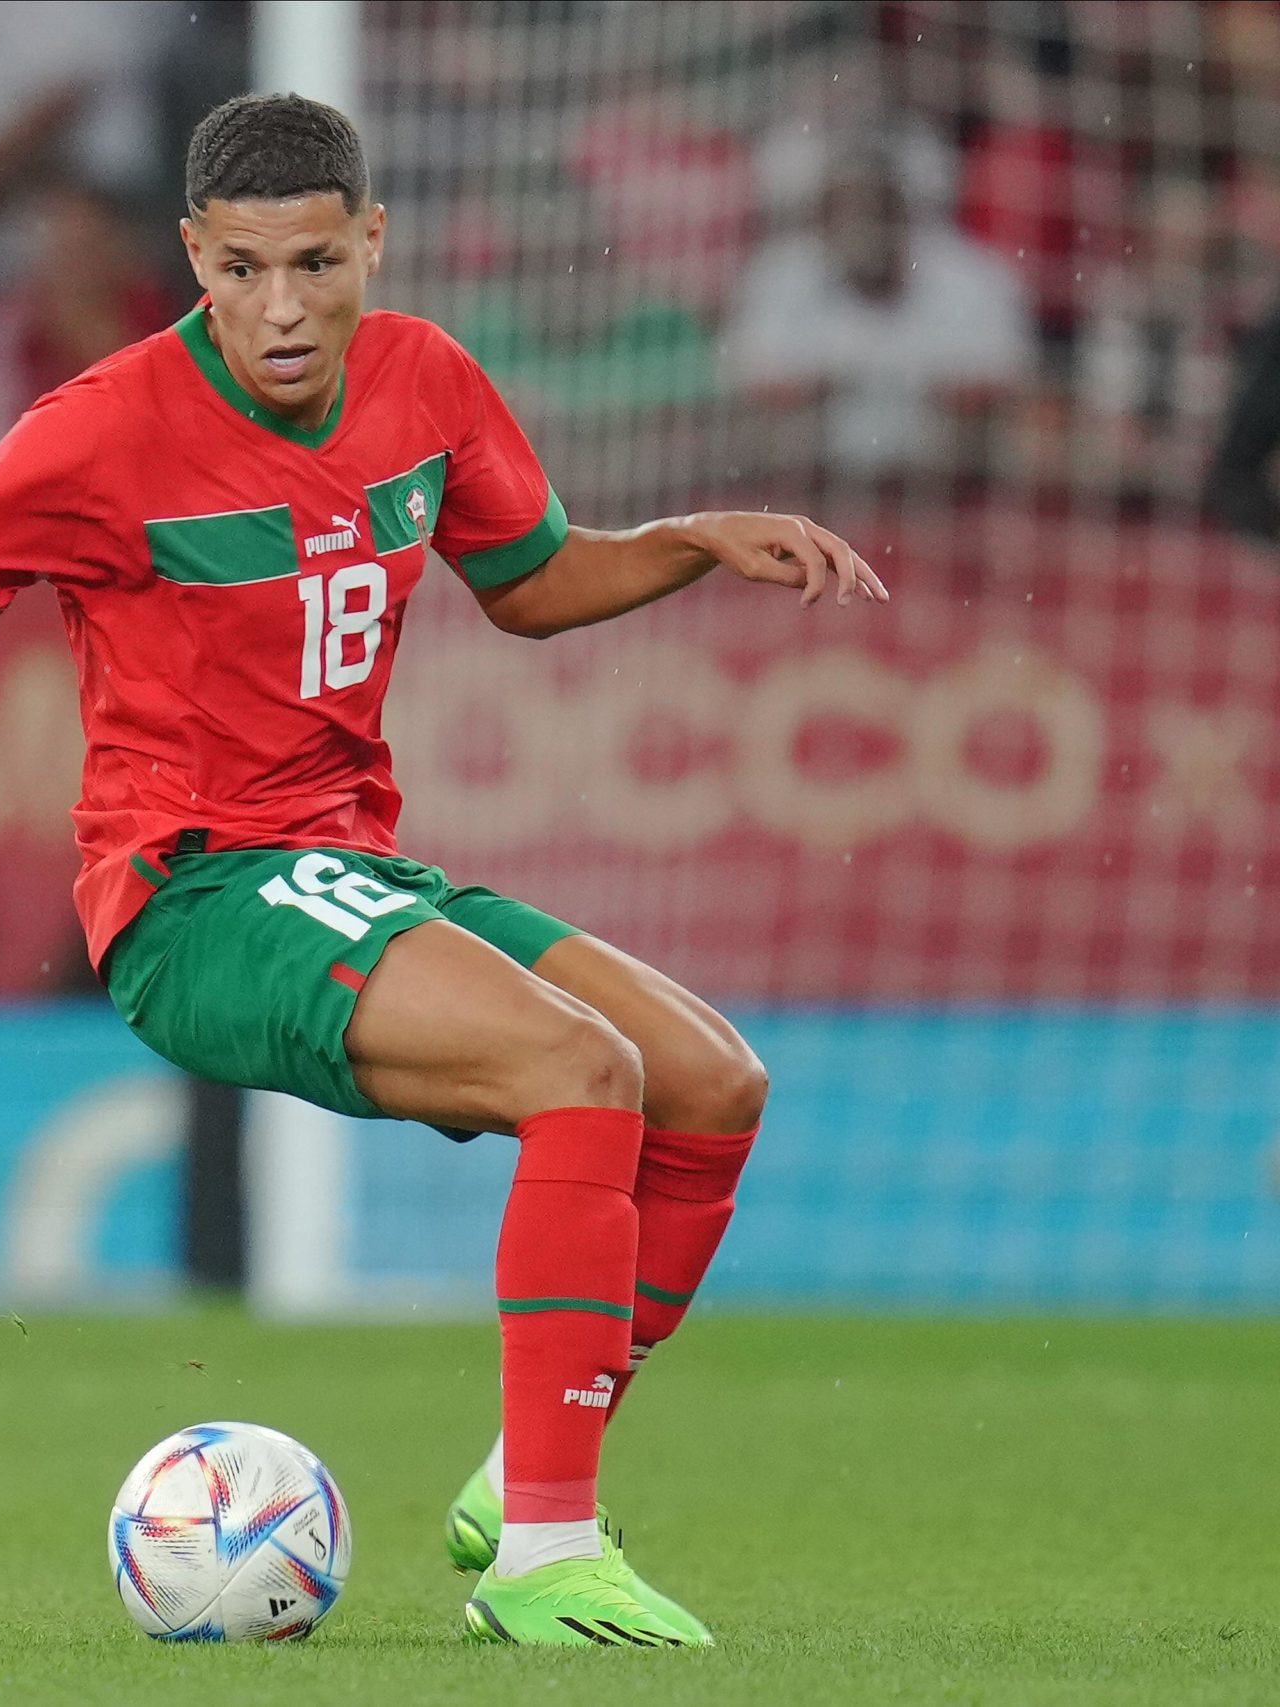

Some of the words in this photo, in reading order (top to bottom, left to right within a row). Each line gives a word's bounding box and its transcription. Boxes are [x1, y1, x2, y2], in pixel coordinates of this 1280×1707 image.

[304, 529, 355, 558] PUMA
[297, 562, 388, 700] 18
[562, 1388, 611, 1409] PUM
